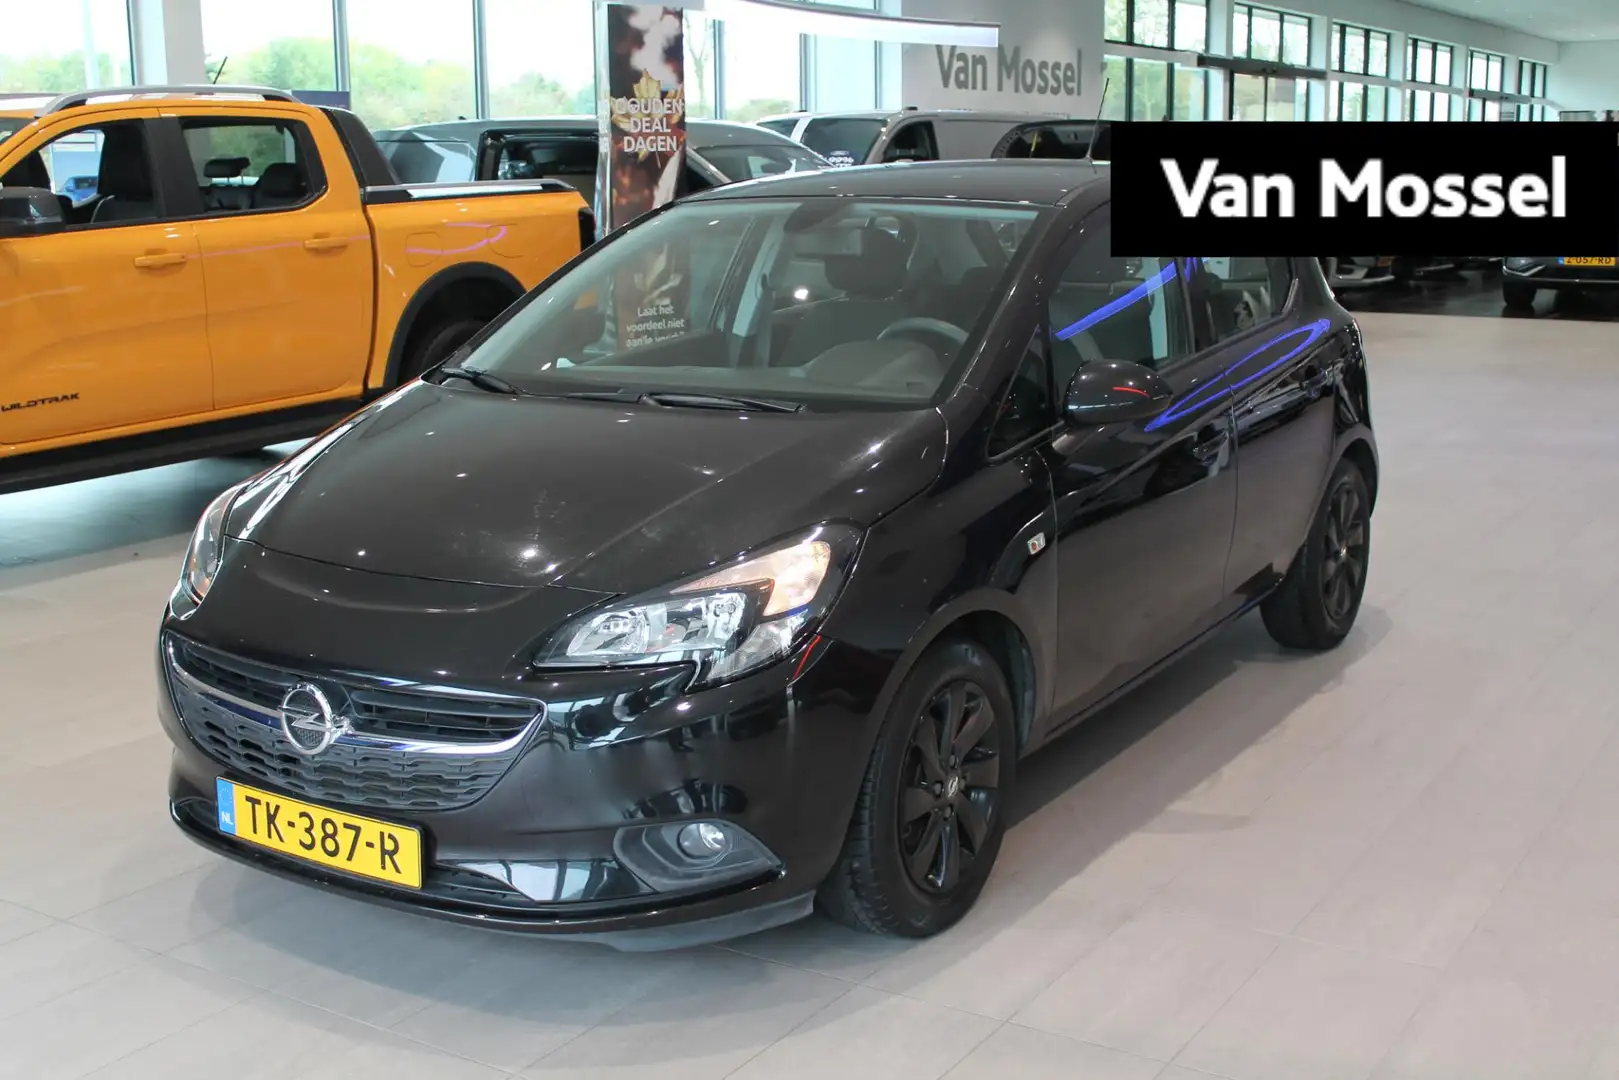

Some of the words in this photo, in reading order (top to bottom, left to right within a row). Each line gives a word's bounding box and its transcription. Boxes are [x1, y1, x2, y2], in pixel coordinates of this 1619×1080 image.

[936, 44, 988, 91] Van
[997, 45, 1082, 96] Mossel
[615, 97, 683, 115] GOUDEN
[629, 117, 671, 133] DEAL
[623, 135, 677, 152] DAGEN
[637, 306, 658, 317] Laat
[659, 304, 674, 315] het
[626, 319, 666, 332] voordeel
[667, 318, 685, 329] niet
[221, 811, 234, 826] NL
[245, 795, 402, 874] TK-387-R
